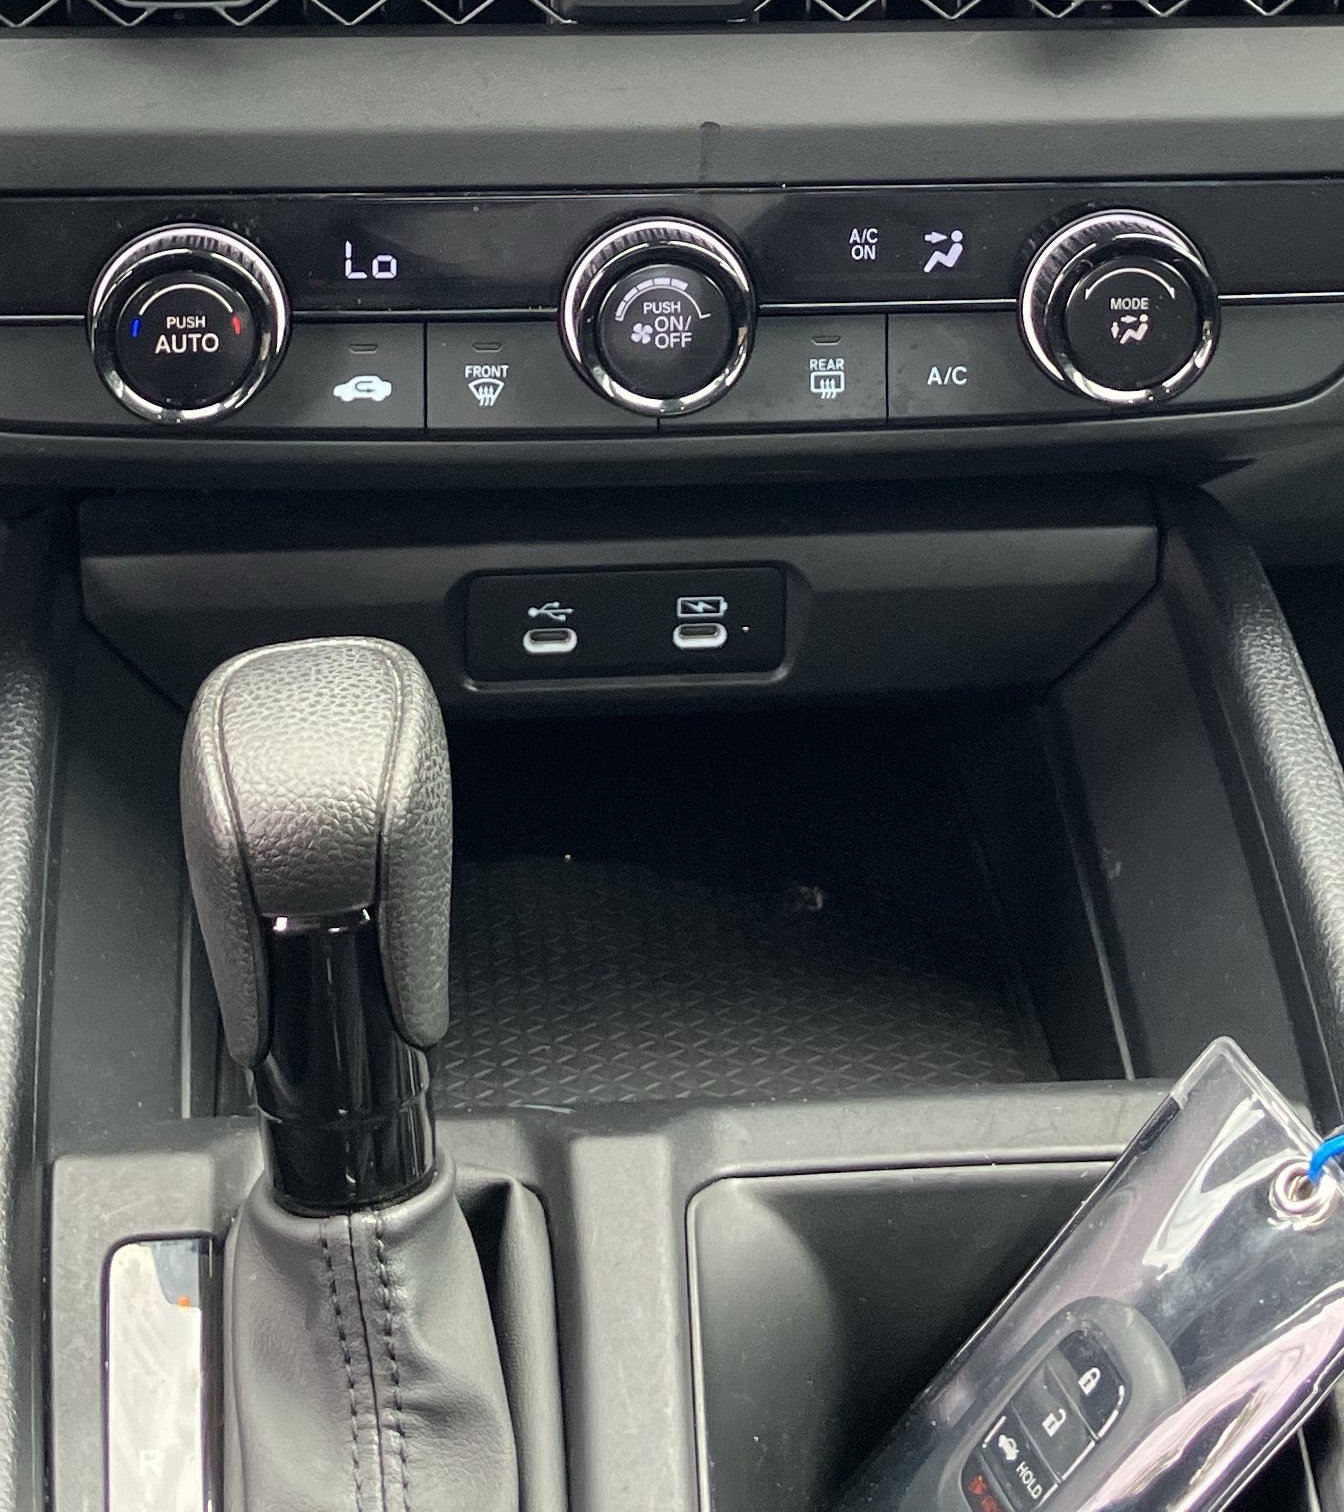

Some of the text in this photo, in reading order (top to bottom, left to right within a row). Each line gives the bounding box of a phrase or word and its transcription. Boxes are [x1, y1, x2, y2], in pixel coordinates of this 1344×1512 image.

[849, 228, 879, 245] A/C
[343, 240, 398, 280] Lo
[851, 244, 876, 261] ON
[643, 301, 682, 315] PUSH
[1110, 297, 1150, 311] MODE
[166, 315, 207, 329] PUSH
[654, 315, 692, 332] ON/
[155, 332, 220, 354] AUTO
[654, 332, 693, 349] OFF
[464, 364, 509, 379] FRONT
[809, 358, 845, 371] REAR
[926, 366, 968, 386] A/C
[1015, 1460, 1044, 1500] HOLD
